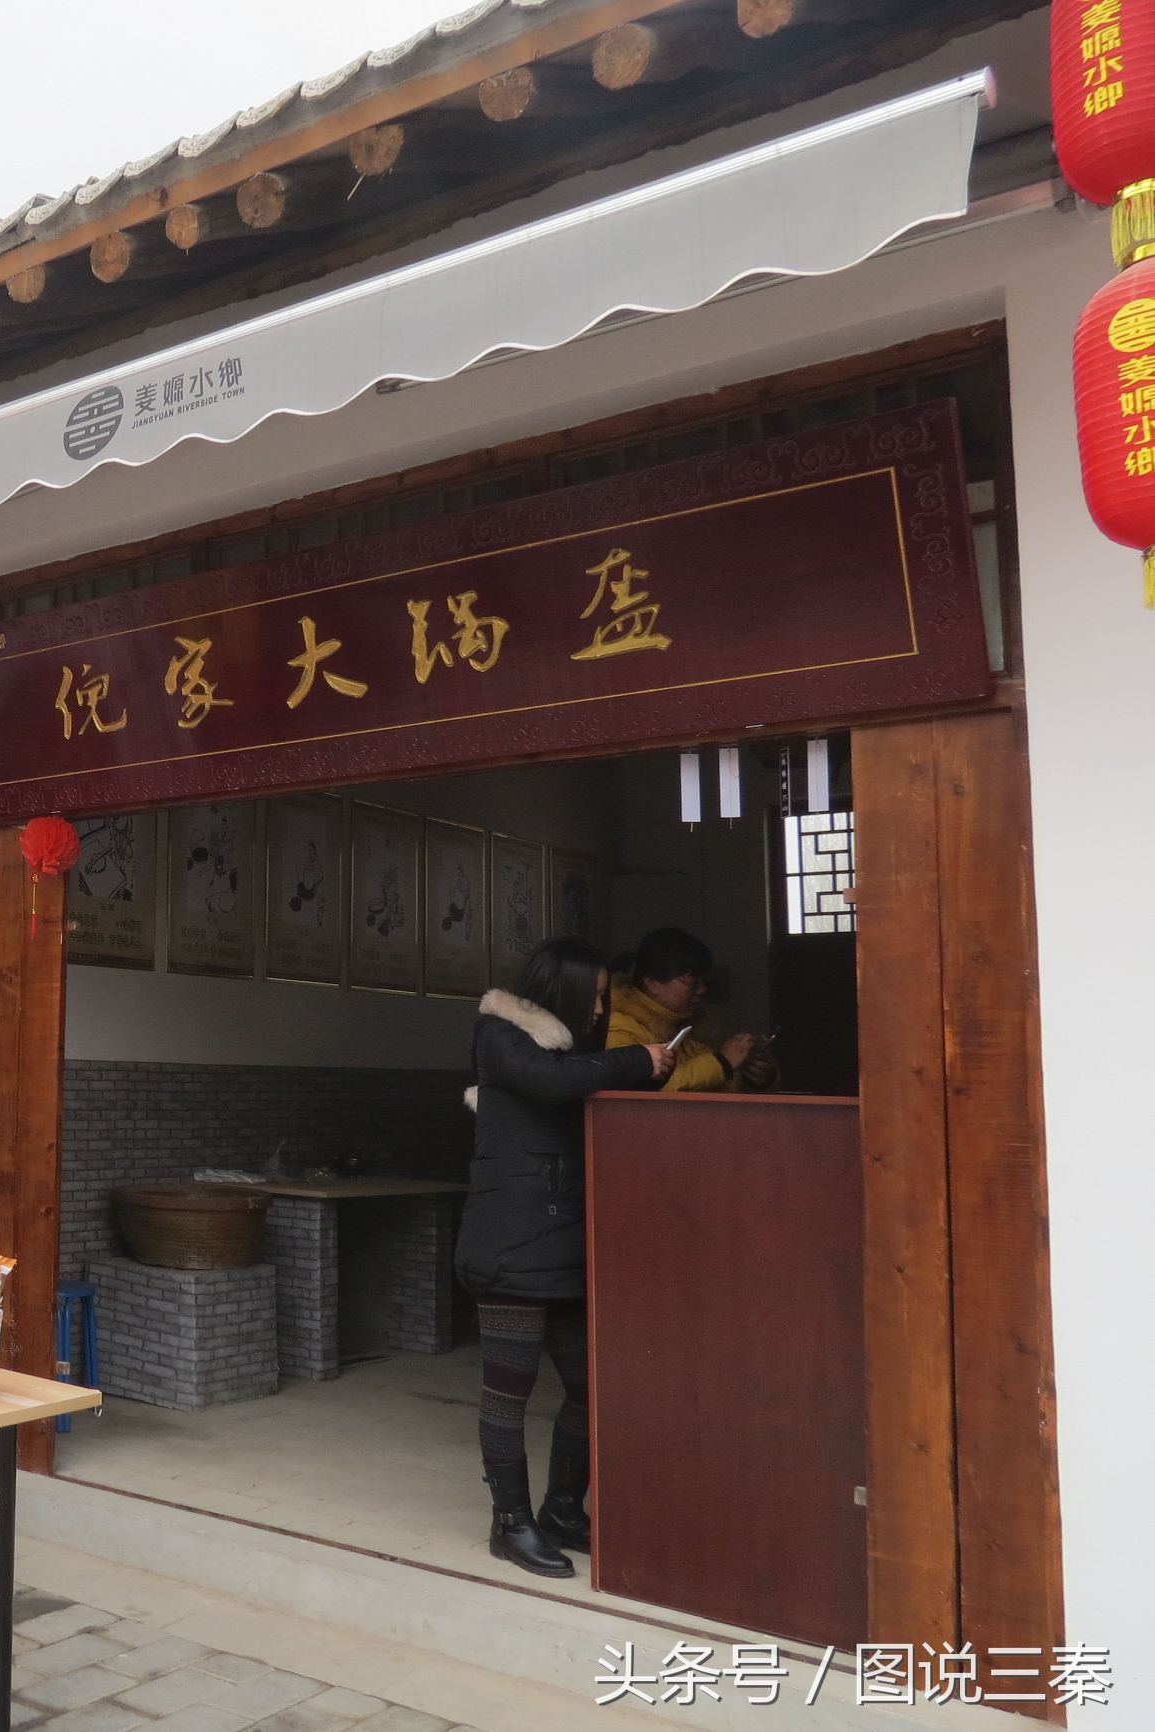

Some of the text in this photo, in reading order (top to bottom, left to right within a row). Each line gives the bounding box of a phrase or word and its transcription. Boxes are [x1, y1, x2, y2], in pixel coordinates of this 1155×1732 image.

[131, 387, 245, 430] JIANGYUAN RIVERSIDE TOWN
[54, 548, 673, 741] 倪家大锅盔
